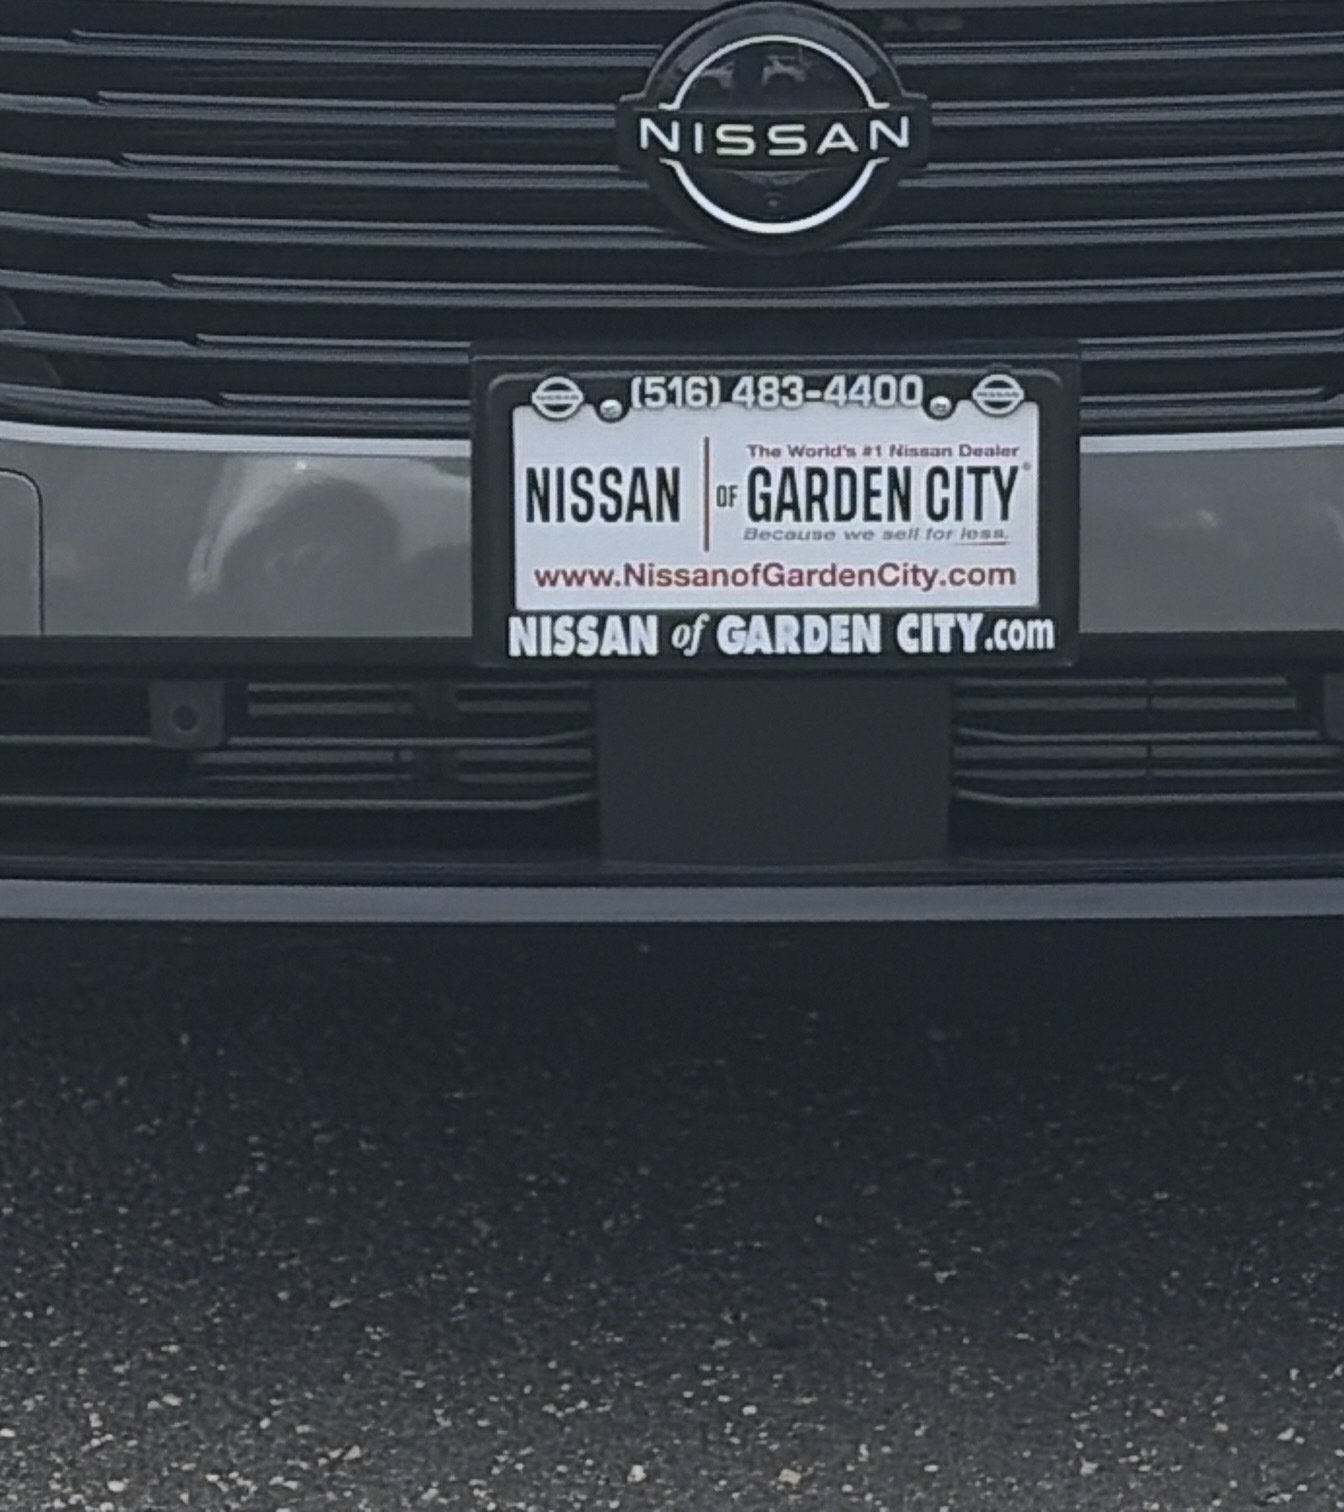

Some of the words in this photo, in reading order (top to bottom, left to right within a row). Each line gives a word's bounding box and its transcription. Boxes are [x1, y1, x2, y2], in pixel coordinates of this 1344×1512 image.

[639, 116, 910, 157] NISSAN
[631, 375, 720, 409] (516)
[732, 374, 924, 409] 483-4400
[747, 444, 782, 458] The
[787, 443, 856, 458] World's
[862, 444, 883, 457] #1
[889, 444, 953, 458] Nissan
[958, 443, 1020, 457] Dealer
[525, 466, 680, 523] NISSAN
[716, 485, 738, 508] OF
[747, 466, 911, 523] GARDEN
[926, 465, 1019, 522] CITY
[743, 527, 836, 541] Because
[843, 530, 876, 541] we
[881, 527, 920, 541] sell
[926, 527, 954, 541] for
[960, 526, 1009, 541] less.
[535, 561, 1016, 592] www.NissanofGardenCity.com
[508, 616, 658, 657] NISSAN
[670, 613, 707, 657] of
[717, 614, 881, 655] GARDEN
[896, 613, 1055, 652] CITY.com
